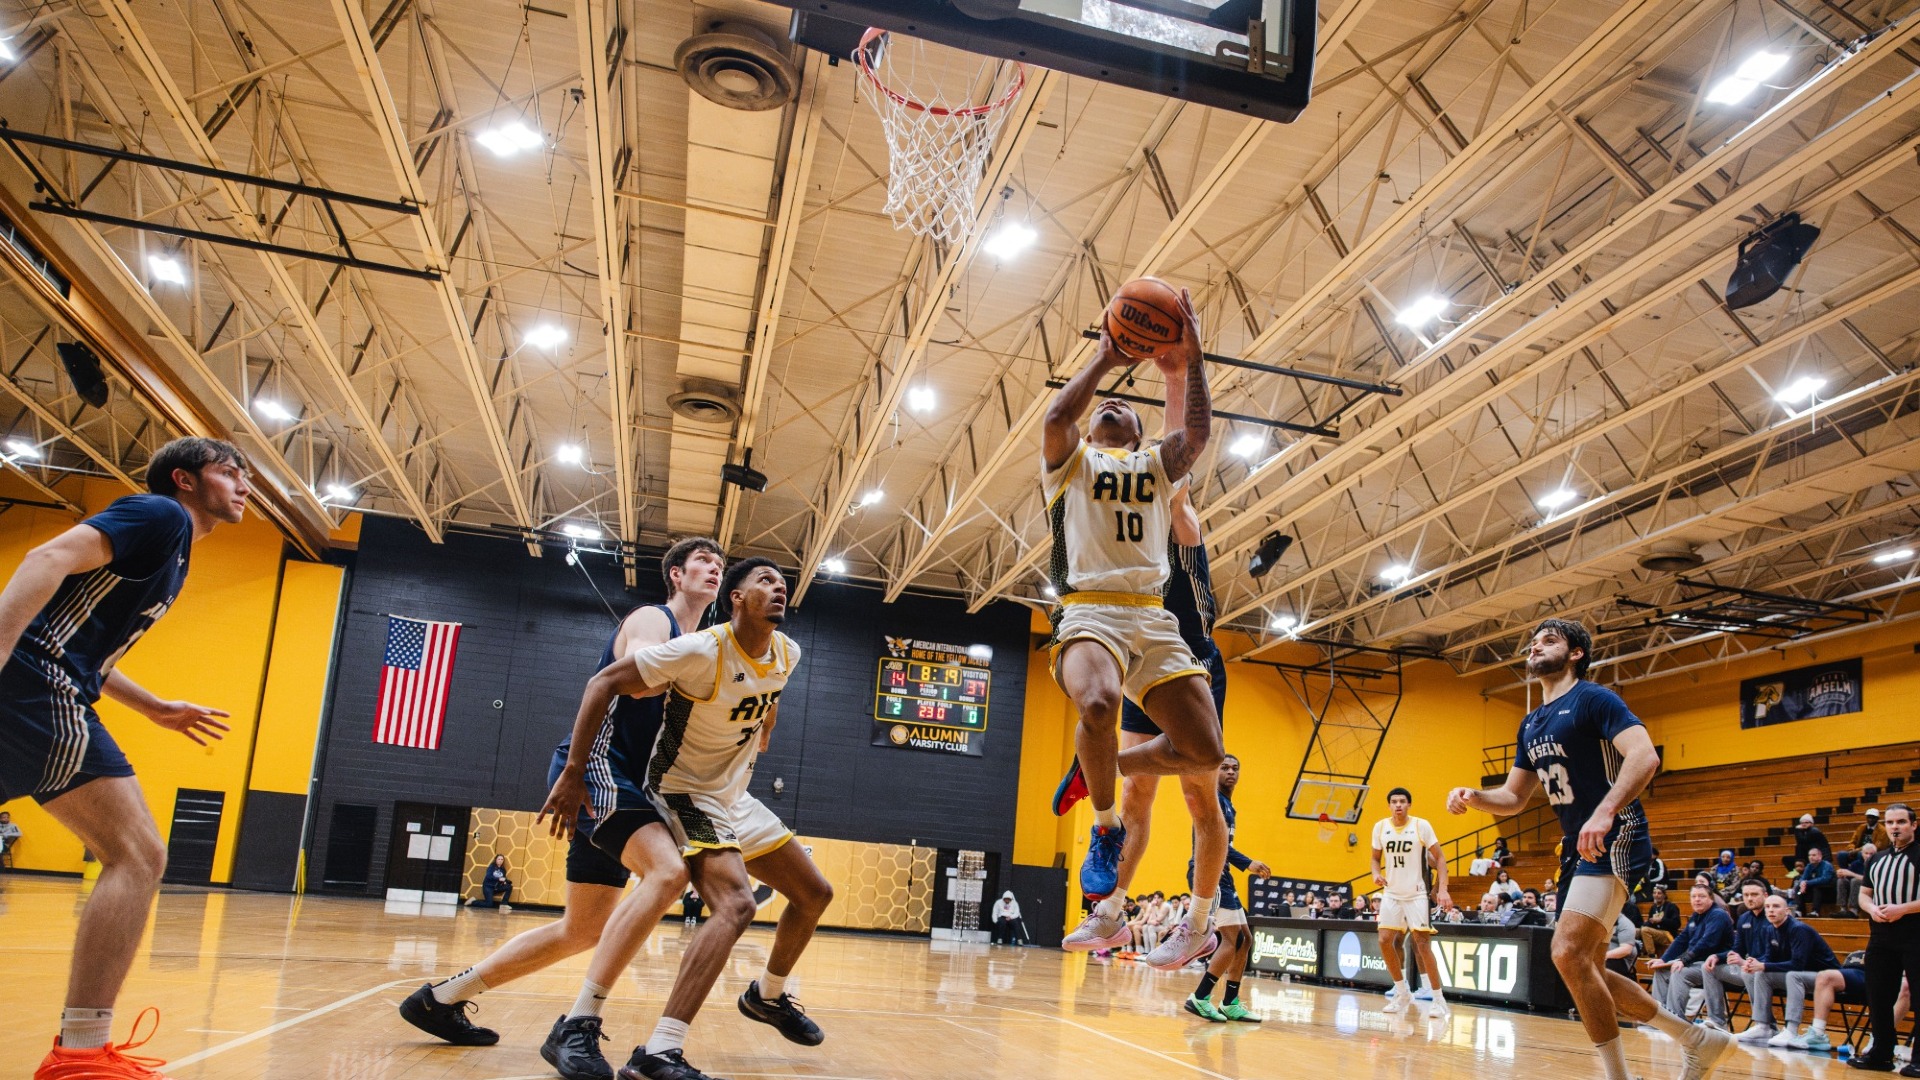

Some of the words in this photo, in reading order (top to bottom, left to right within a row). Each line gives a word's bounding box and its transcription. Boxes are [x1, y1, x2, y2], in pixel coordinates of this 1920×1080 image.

[1120, 303, 1170, 338] Wilson
[1117, 331, 1156, 354] NCAA
[1092, 471, 1156, 504] AIC
[1115, 511, 1143, 542] 10
[912, 640, 936, 651] AMERICAN
[911, 649, 927, 659] HOME
[926, 650, 934, 660] OF
[935, 652, 945, 662] THE
[946, 653, 967, 664] YELLOW
[892, 671, 905, 686] 14
[921, 666, 958, 684] 8:19
[962, 670, 988, 680] VISITOR
[943, 688, 948, 700] 1
[967, 680, 986, 697] 37
[1808, 681, 1852, 702] ANSELM
[886, 695, 902, 703] FOULS
[917, 699, 935, 707] PLAYER
[936, 701, 953, 709] FOULS
[893, 702, 902, 715] 2
[919, 706, 934, 718] 23
[936, 707, 945, 720] 0
[969, 710, 978, 723] 0
[909, 726, 969, 744] ALUMNI
[1527, 734, 1554, 749] SAINT
[1386, 840, 1413, 853] AIC
[1393, 855, 1405, 868] 14
